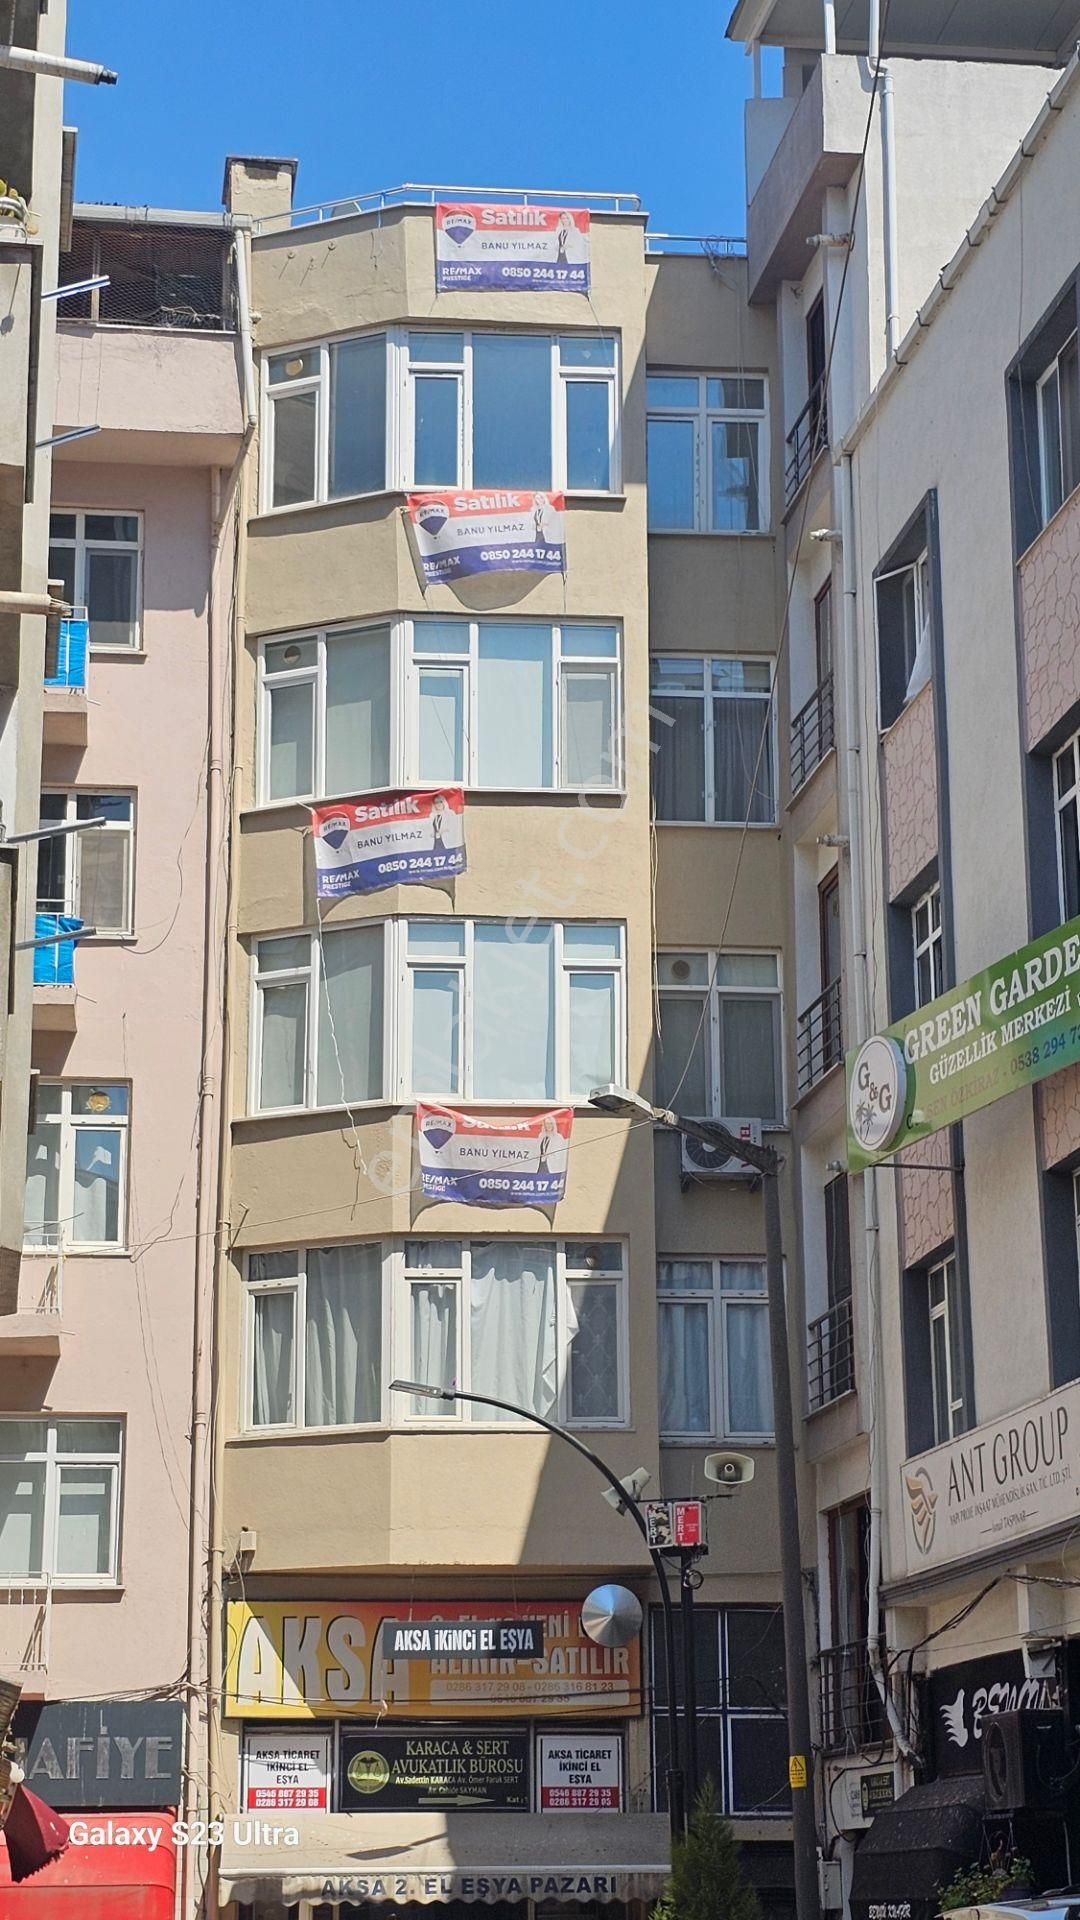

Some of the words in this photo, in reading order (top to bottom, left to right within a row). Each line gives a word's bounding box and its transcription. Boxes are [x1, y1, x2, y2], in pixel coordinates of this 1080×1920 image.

[481, 209, 547, 226] Satılık
[481, 241, 509, 250] BANU
[511, 242, 549, 251] YILMAZ
[442, 267, 483, 276] RE/MAX
[502, 267, 531, 278] 0850
[533, 268, 554, 279] 244
[556, 269, 568, 280] 17
[569, 269, 586, 280] 44
[454, 492, 521, 511] Satılık
[457, 527, 485, 537] BANU
[488, 523, 525, 533] YILMAZ
[480, 549, 511, 562] 0850
[512, 549, 534, 560] 244
[536, 549, 545, 560] 17
[546, 550, 562, 561] 44
[423, 555, 461, 572] RE/MAX
[355, 797, 421, 823] Satılık
[357, 836, 383, 849] BANU
[386, 831, 423, 844] YILMAZ
[378, 861, 408, 874] 0850
[409, 857, 433, 869] 244
[434, 856, 446, 867] 17
[448, 853, 463, 865] 44
[322, 869, 360, 884] RE/MAX
[904, 991, 982, 1064] GREEN
[929, 1031, 998, 1084] GÜZELLİK
[1000, 985, 1071, 1047] MERKEZİ
[1010, 1047, 1040, 1075] 0538
[1043, 1033, 1067, 1059] 294
[858, 1062, 870, 1091] G
[878, 1083, 892, 1113] G
[459, 1147, 488, 1157] BANU
[492, 1149, 530, 1160] YILMAZ
[479, 1178, 510, 1190] 0850
[512, 1178, 535, 1191] 244
[537, 1178, 549, 1191] 17
[948, 1442, 986, 1506] ANT
[993, 1406, 1069, 1485] GROUP
[677, 1507, 686, 1542] MERT
[395, 1629, 431, 1651] AKSA
[480, 1629, 497, 1651] EL
[500, 1628, 534, 1653] EŞYA
[585, 1682, 598, 1691] 81
[601, 1682, 614, 1691] 23
[256, 1750, 280, 1760] AKSA
[283, 1748, 320, 1760] TİCARET
[406, 1741, 459, 1755] KARACA
[462, 1740, 473, 1755] &
[477, 1741, 509, 1755] SERT
[548, 1750, 573, 1760] AKSA
[575, 1748, 612, 1760] TİCARET
[299, 1763, 309, 1772] EL
[392, 1759, 466, 1773] AVUKATLIK
[470, 1756, 523, 1773] BÜROSU
[559, 1761, 588, 1772] İKİNCİ
[590, 1762, 601, 1772] EL
[277, 1775, 299, 1785] EŞYA
[430, 1776, 456, 1785] KARACA
[569, 1774, 592, 1785] EŞYA
[308, 1789, 319, 1798] 35
[601, 1789, 611, 1797] 35
[278, 1798, 293, 1807] 317
[571, 1798, 587, 1806] 317
[321, 1879, 386, 1896] AKSA
[395, 1879, 415, 1895] 2.
[424, 1878, 451, 1895] EL
[461, 1877, 523, 1898] EŞYA
[529, 1876, 617, 1895] PAZARI
